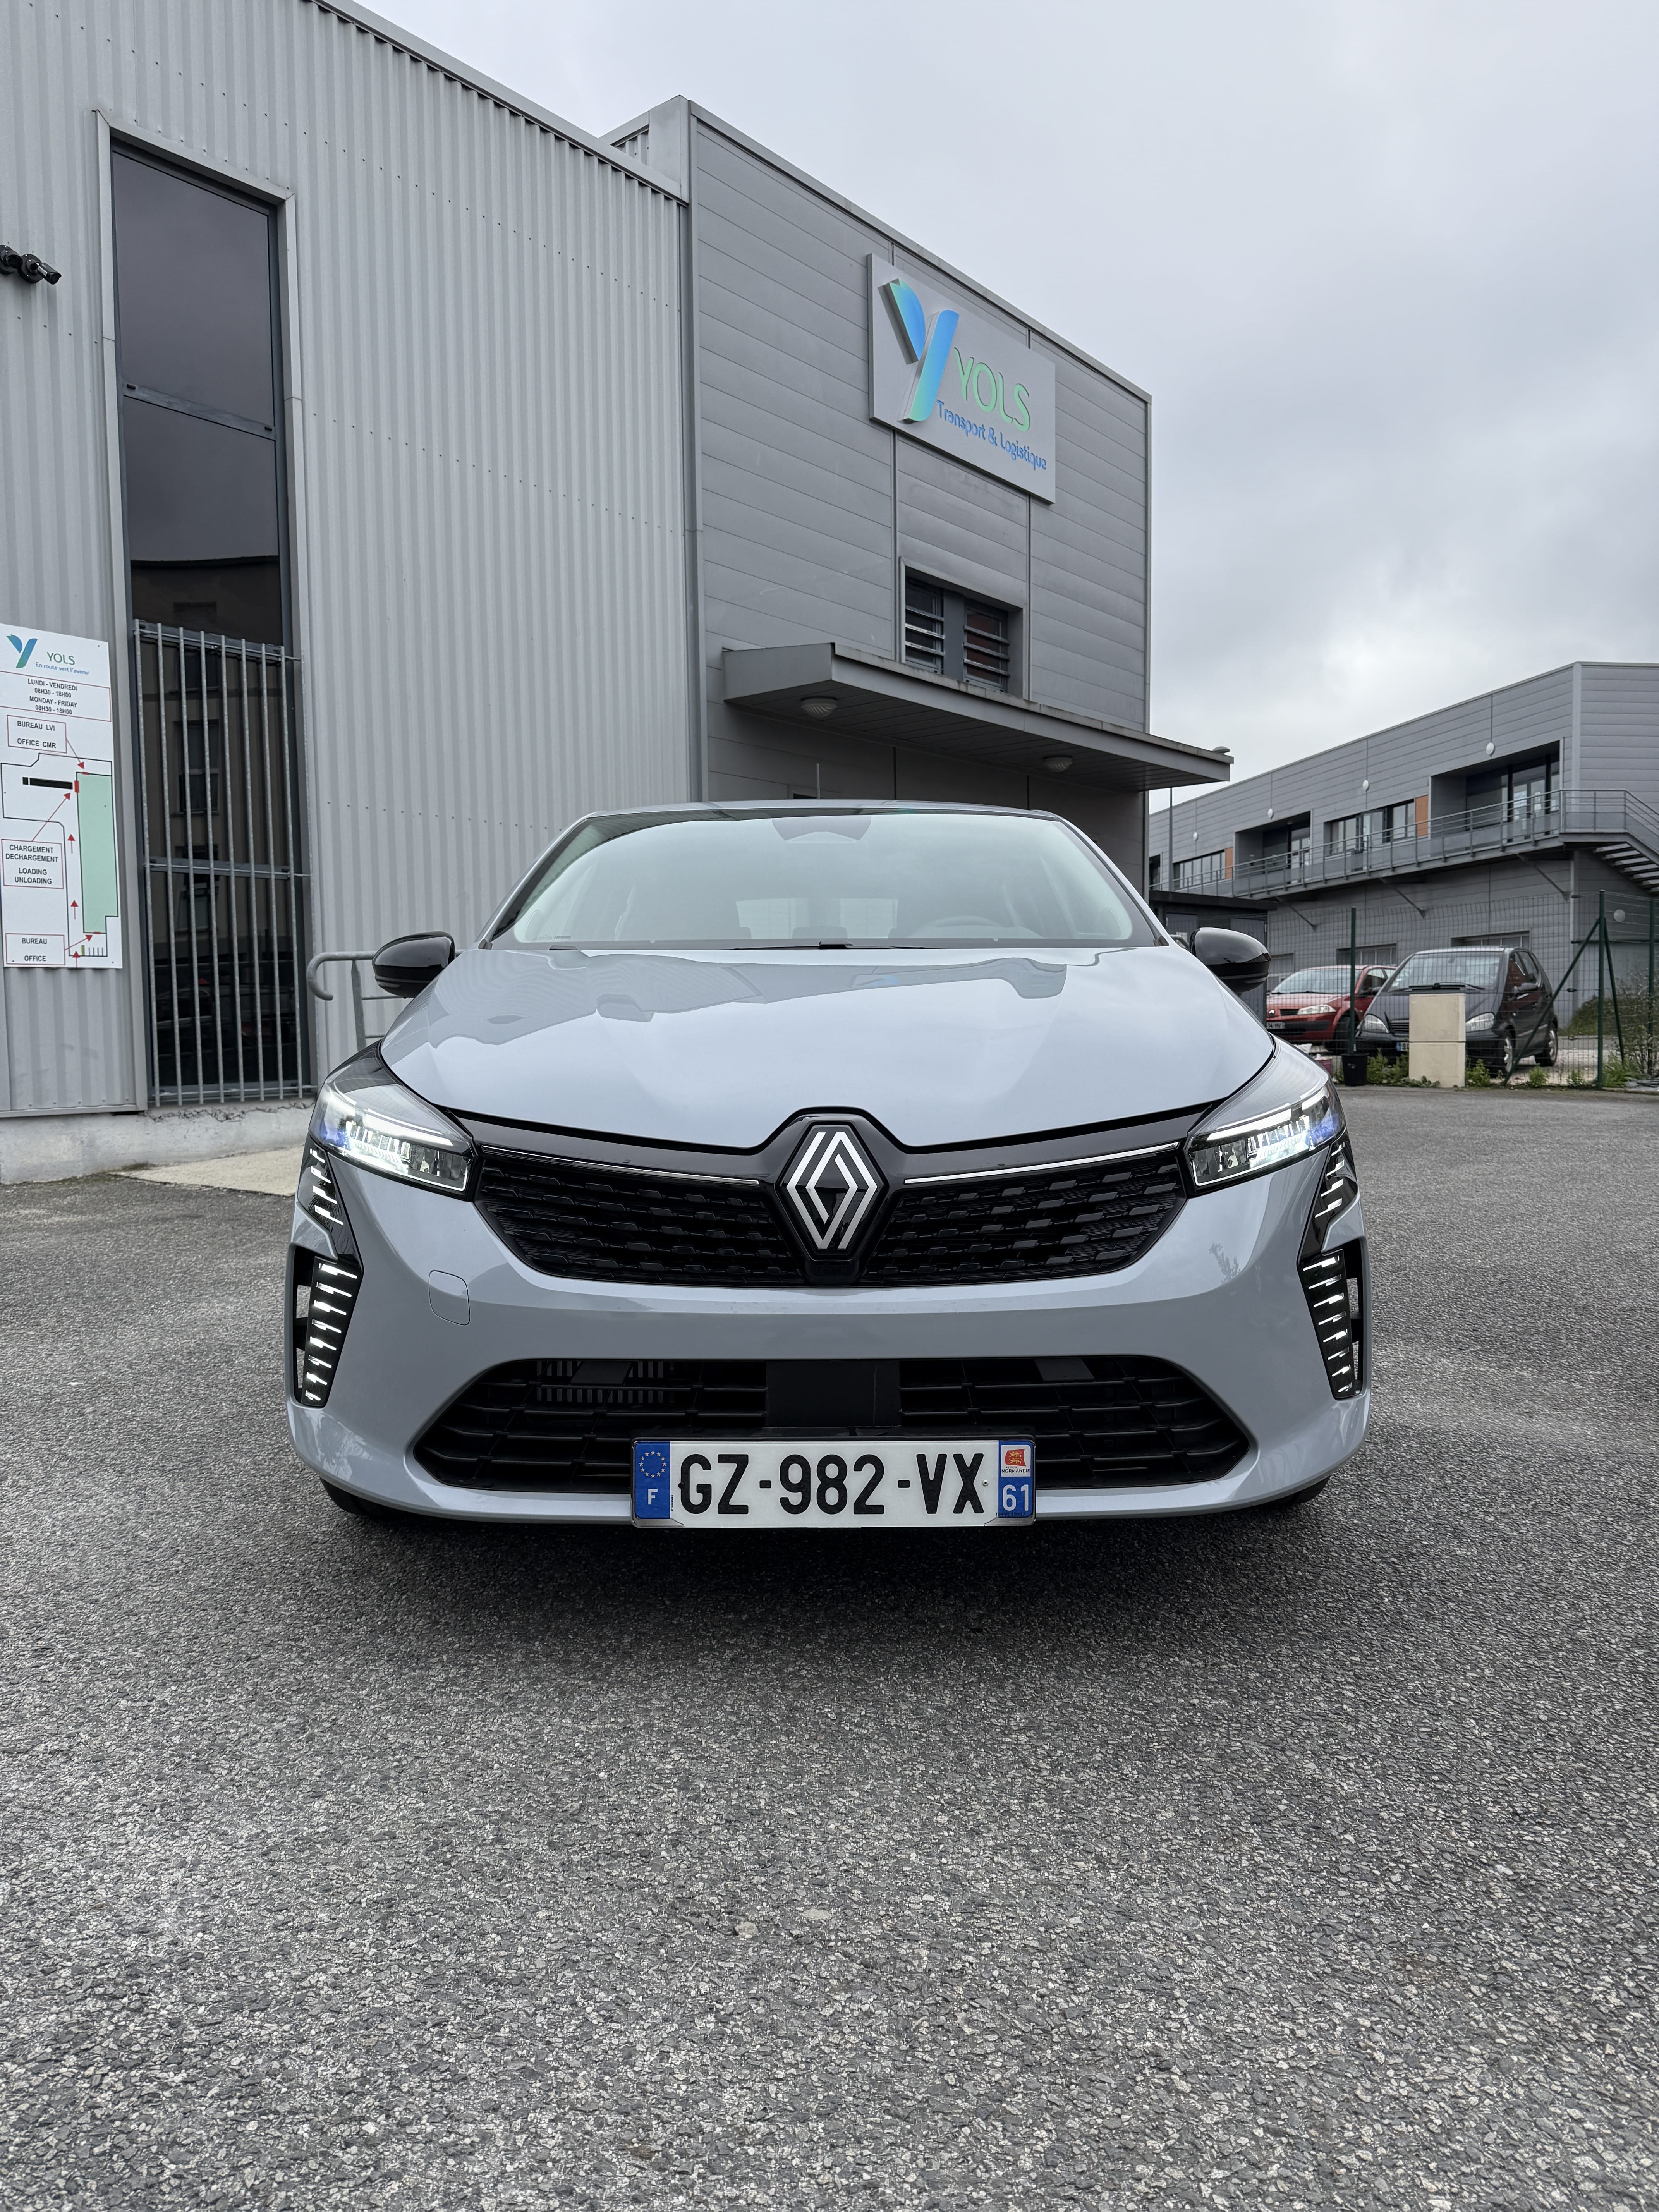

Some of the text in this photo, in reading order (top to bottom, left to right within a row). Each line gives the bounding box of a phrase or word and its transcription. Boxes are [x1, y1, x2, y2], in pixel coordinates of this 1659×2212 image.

[955, 347, 1030, 432] YOLS
[936, 399, 1046, 471] Transport & Logistique
[46, 652, 75, 665] YOLS
[49, 682, 77, 691] VENDREDI
[29, 696, 53, 704] MONDAY
[17, 721, 43, 729] BUREAU
[17, 738, 40, 746] OFFICE
[9, 845, 54, 853] CHARGEMENT
[5, 853, 58, 862] DECHARGEMENT
[15, 876, 52, 884] UNLOADING
[680, 1453, 984, 1515] GZ-982-VX
[648, 1489, 658, 1505] F
[1003, 1484, 1029, 1511] 61
